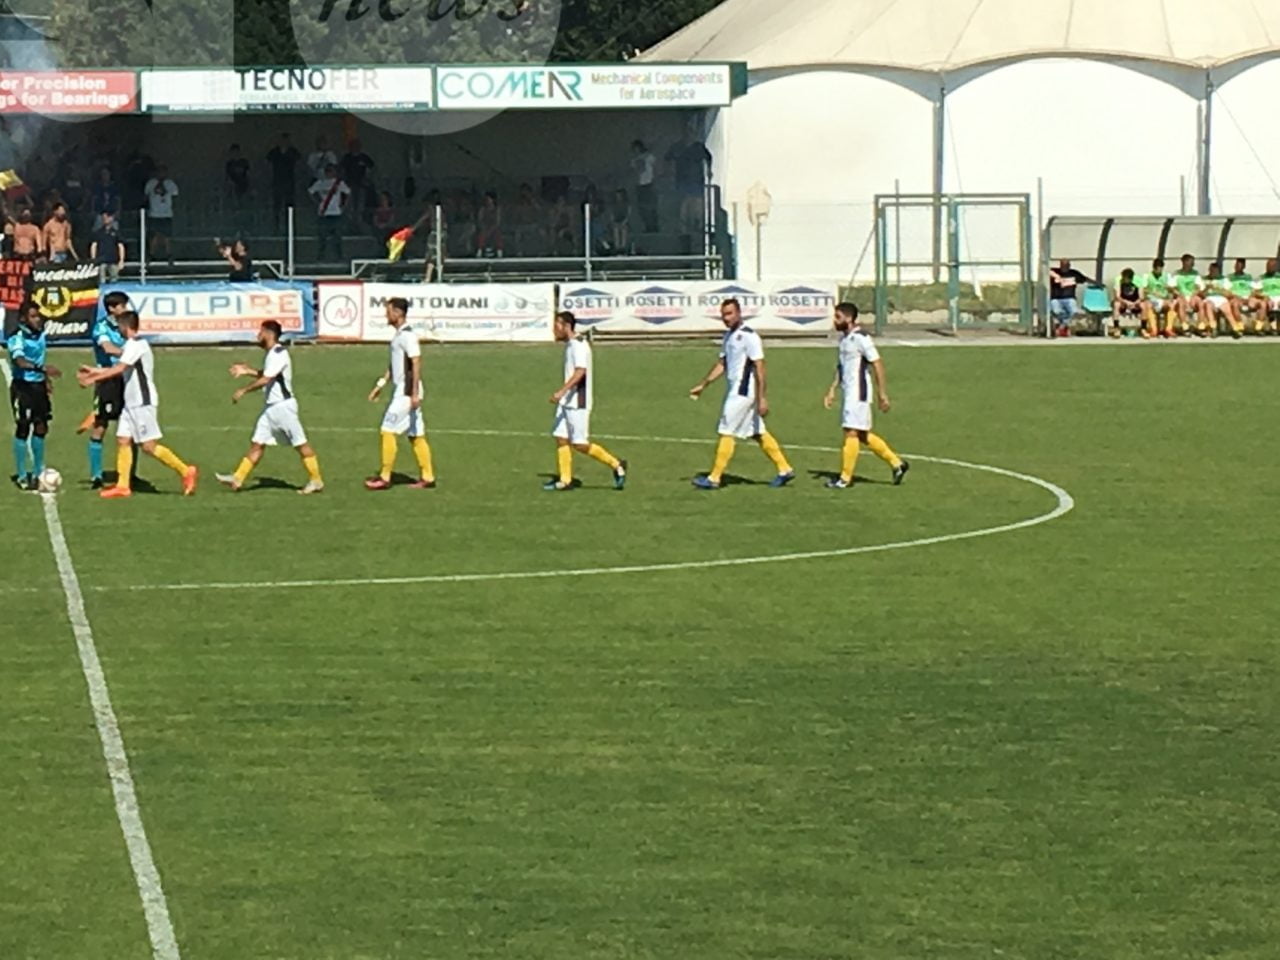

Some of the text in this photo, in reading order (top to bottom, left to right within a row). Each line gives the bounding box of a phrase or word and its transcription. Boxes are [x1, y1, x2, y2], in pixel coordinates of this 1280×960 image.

[21, 76, 107, 90] Precision
[239, 69, 379, 91] TECNOFER
[591, 71, 724, 86] Mechanical Components
[21, 91, 48, 105] for
[51, 91, 129, 107] Bearings
[639, 87, 696, 101] Aerospace
[625, 295, 692, 307] ROSETTI
